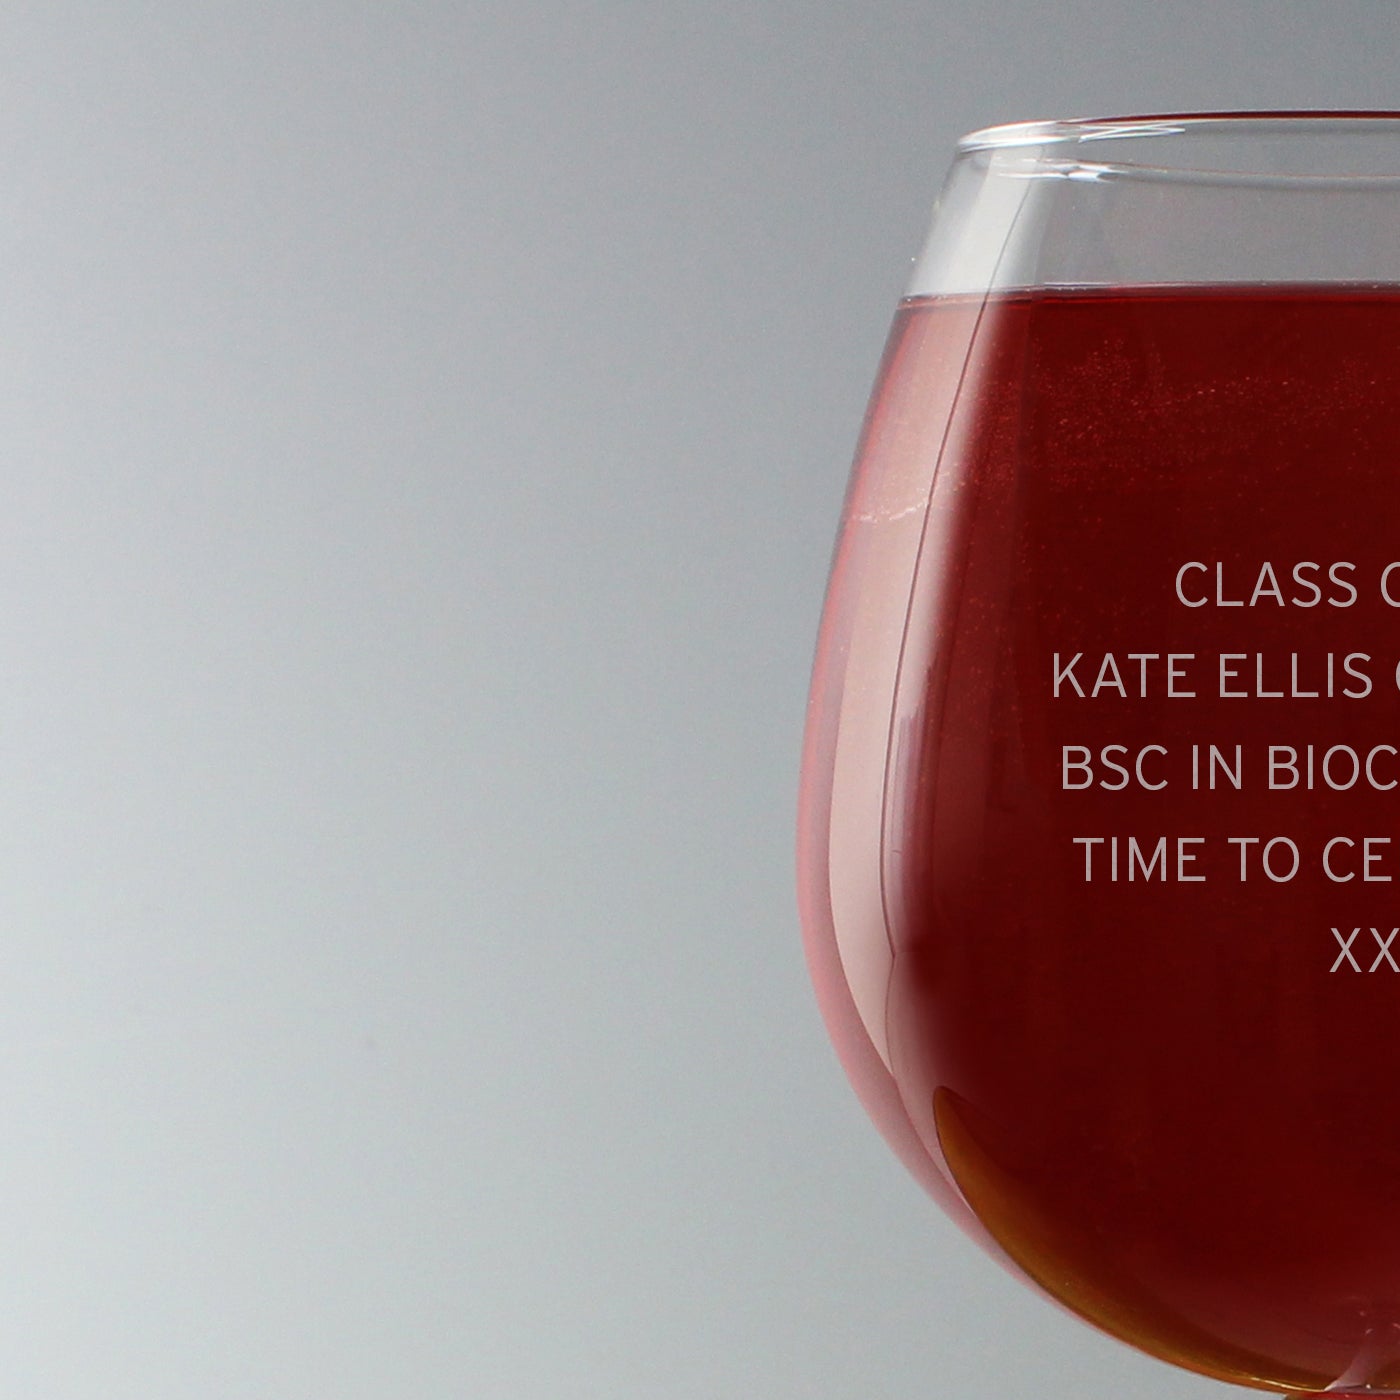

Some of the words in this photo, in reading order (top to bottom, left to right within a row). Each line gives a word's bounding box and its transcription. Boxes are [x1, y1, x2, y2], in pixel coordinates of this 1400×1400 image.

[1176, 562, 1357, 607] CLASS
[1053, 653, 1197, 697] KATE
[1220, 653, 1372, 698] ELLIS
[1063, 745, 1168, 790] BSC
[1193, 745, 1242, 789] IN
[1073, 837, 1206, 882] TIME
[1228, 837, 1300, 882] TO
